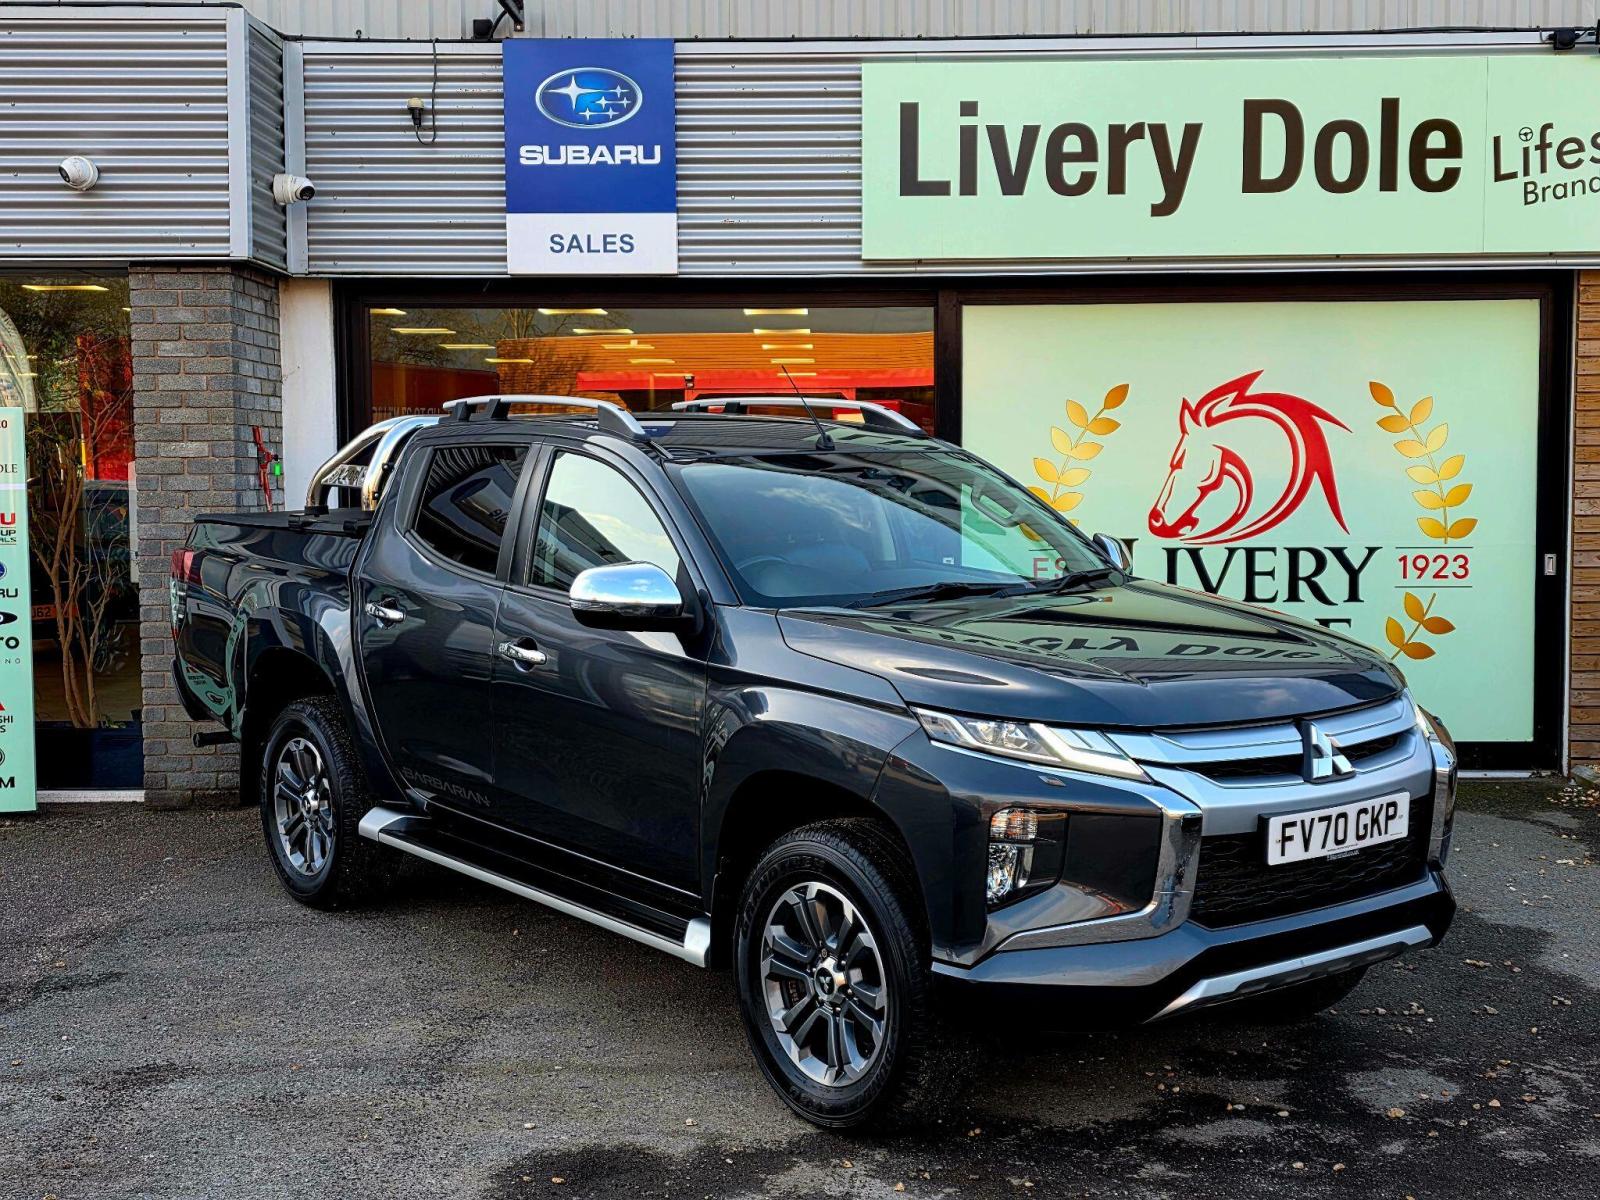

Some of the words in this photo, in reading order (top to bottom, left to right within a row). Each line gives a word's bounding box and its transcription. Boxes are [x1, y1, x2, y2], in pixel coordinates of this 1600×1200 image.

[519, 144, 661, 165] SUBARU
[899, 100, 1203, 217] Livery
[1241, 97, 1463, 194] Dole
[549, 233, 635, 254] SALES
[1398, 554, 1470, 580] 1923
[402, 766, 491, 807] BARBARIAN
[1280, 812, 1349, 856] FV70
[1355, 800, 1399, 841] GKP
